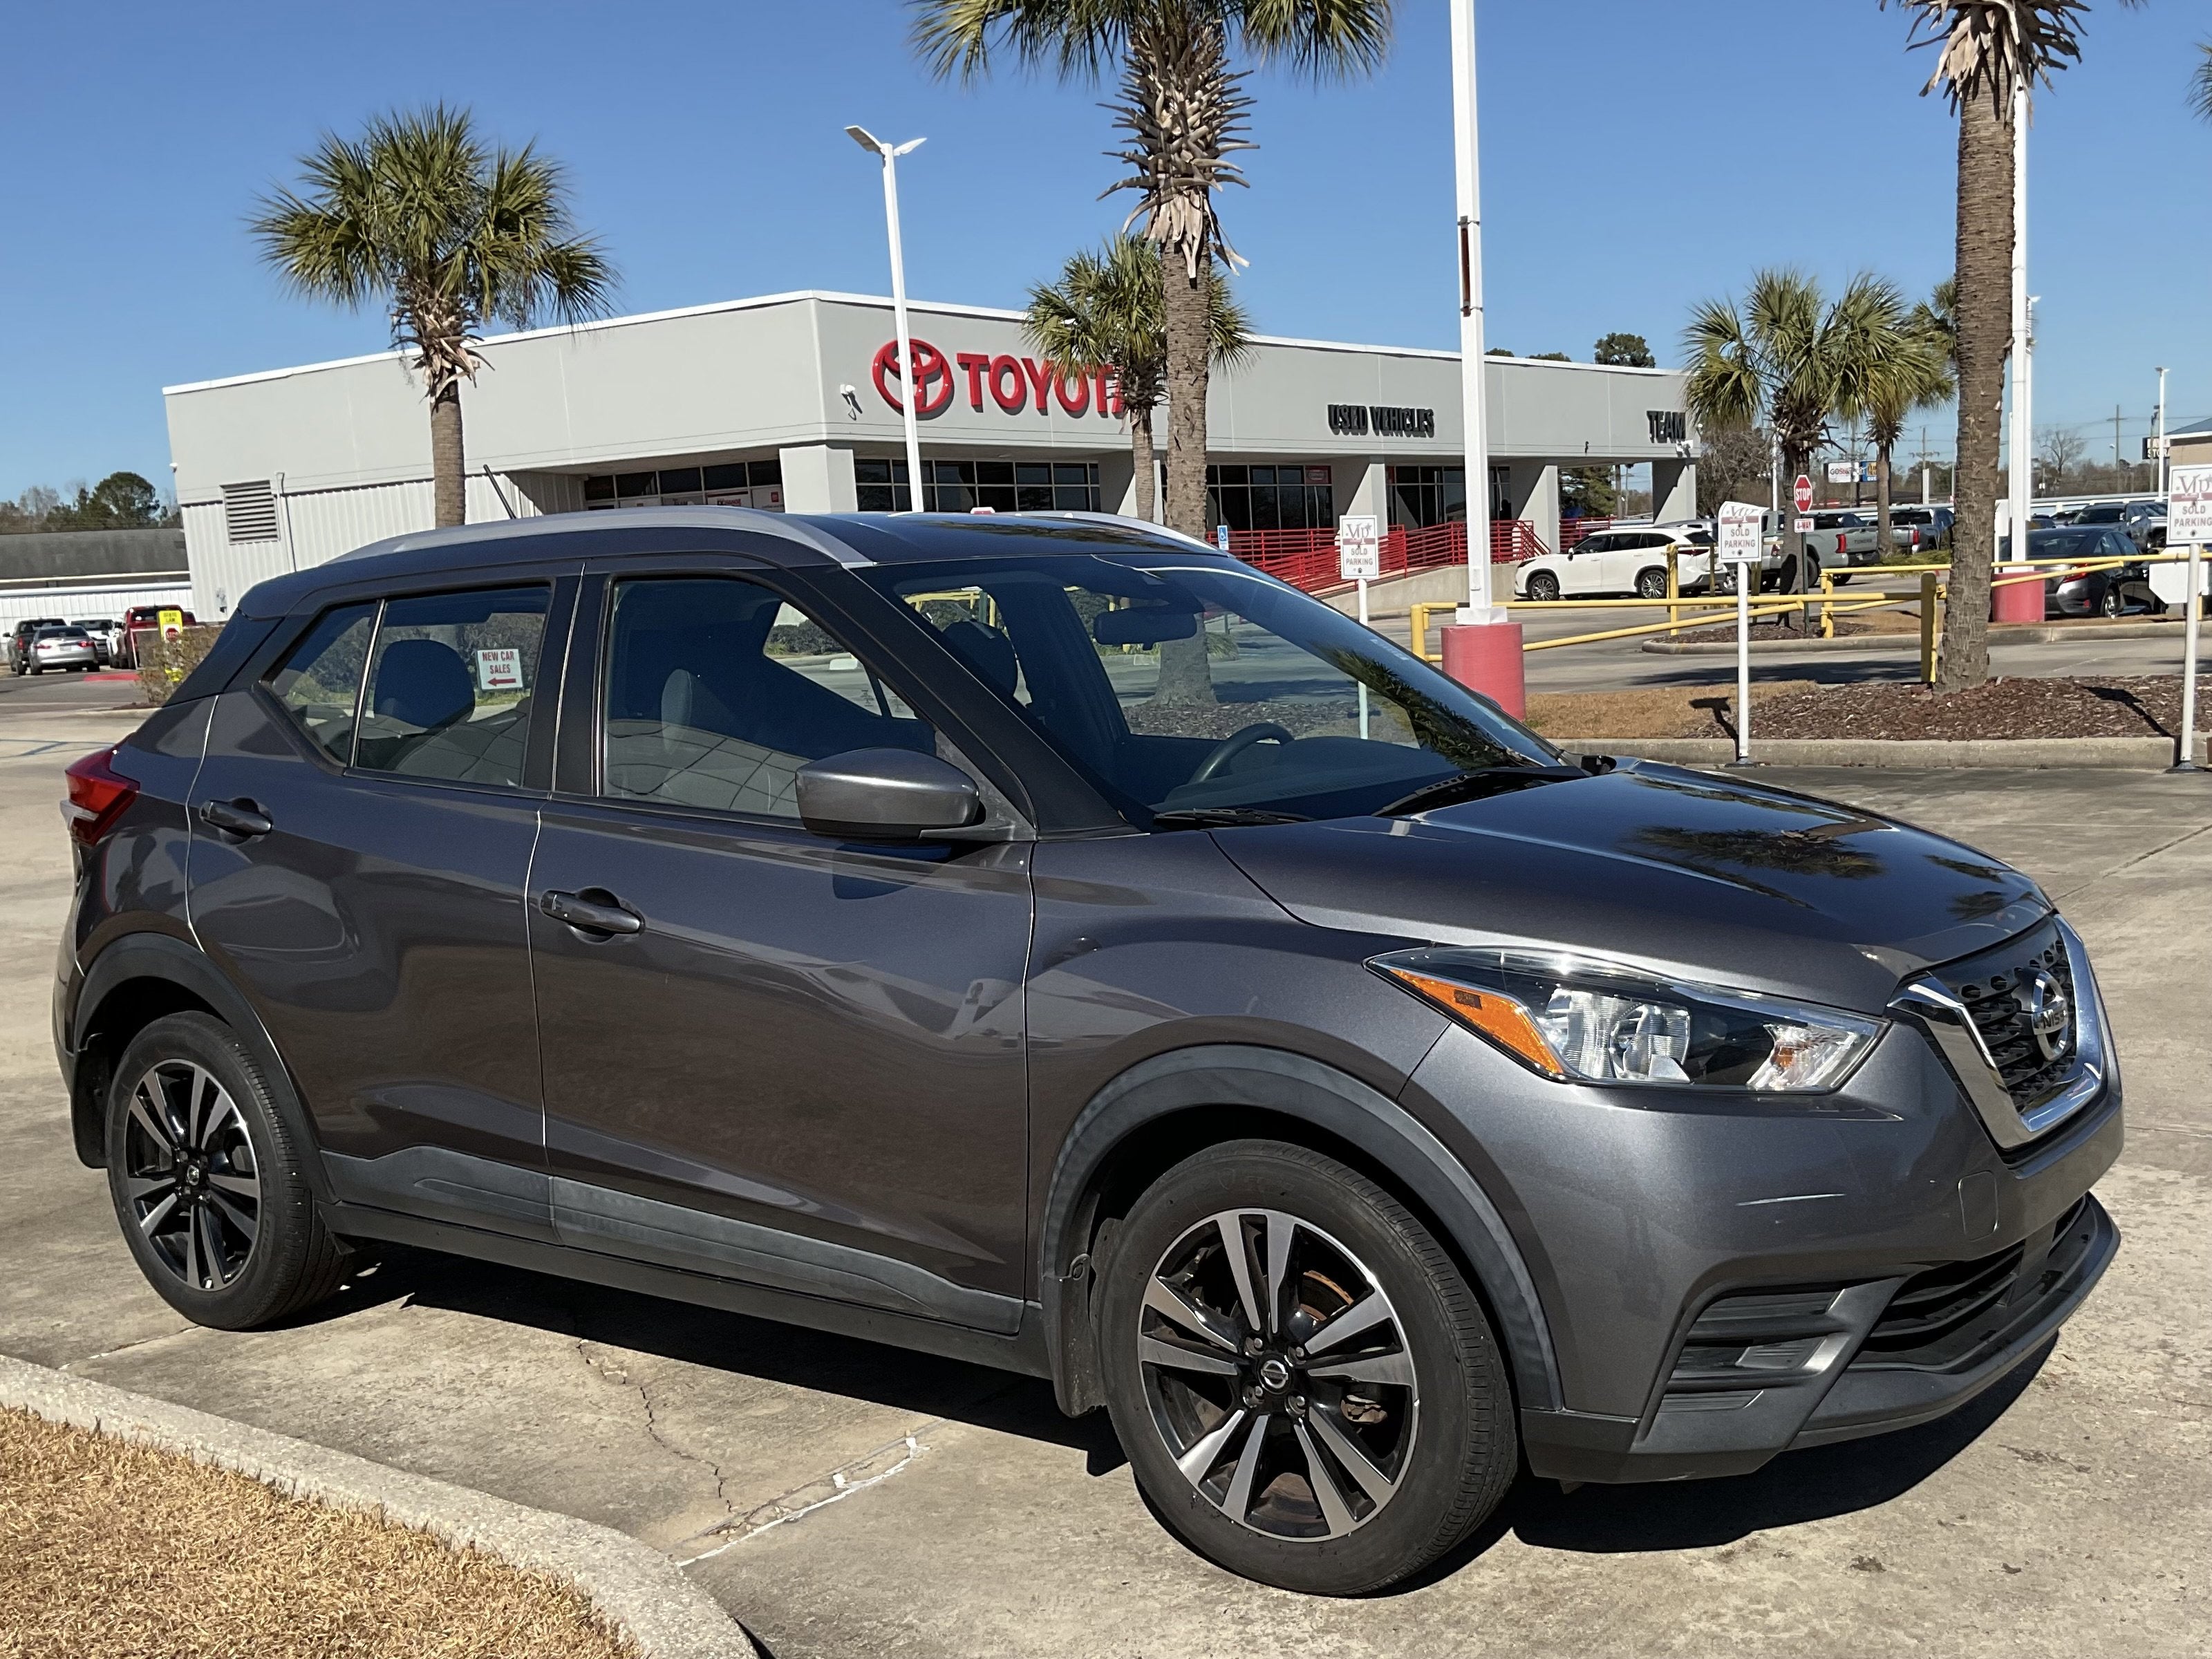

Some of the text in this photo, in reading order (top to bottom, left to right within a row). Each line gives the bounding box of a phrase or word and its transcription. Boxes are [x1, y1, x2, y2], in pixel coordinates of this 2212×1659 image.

[1328, 404, 1434, 438] USED VEHICLES
[1647, 411, 1686, 443] TEAM
[1795, 488, 1811, 501] STOP
[2182, 505, 2205, 514] SOLD
[1797, 521, 1811, 529] 4-WAY
[2174, 517, 2212, 527] PARKING
[1725, 539, 1755, 547] PARKING
[482, 651, 515, 661] NEW CAR
[489, 664, 511, 674] SALES
